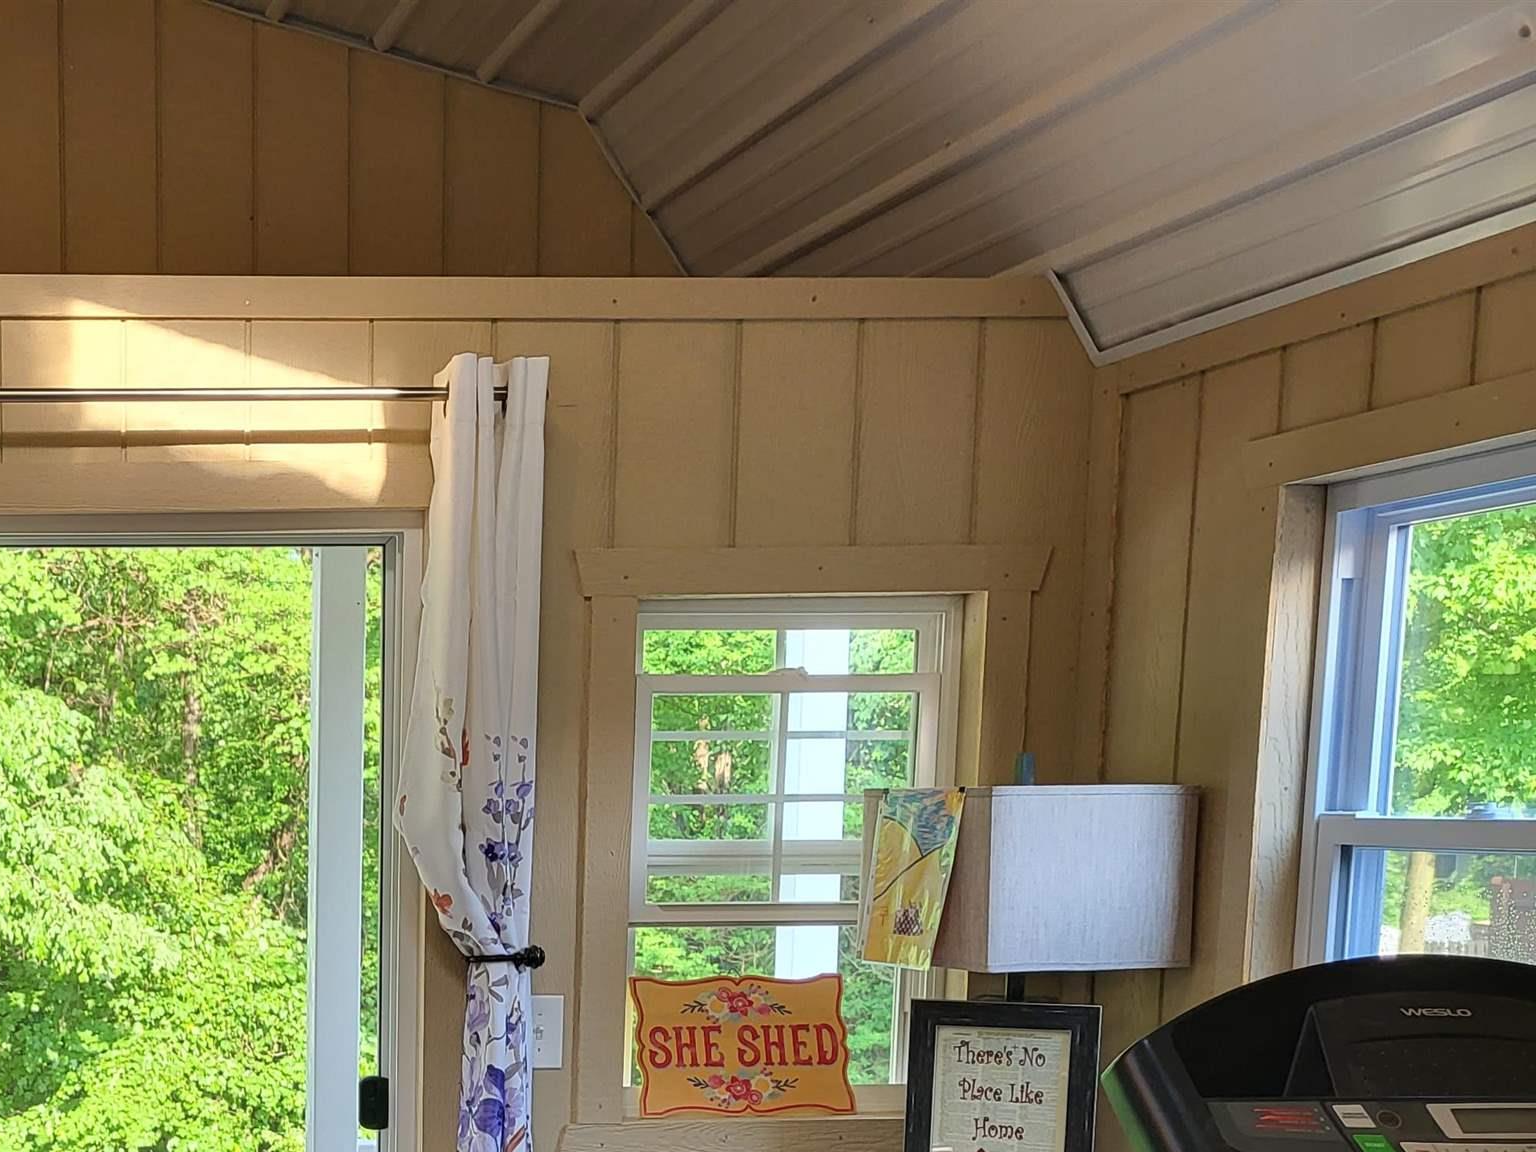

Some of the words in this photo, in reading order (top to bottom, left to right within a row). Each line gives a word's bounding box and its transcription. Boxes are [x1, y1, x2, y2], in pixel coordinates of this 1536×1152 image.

[1400, 1007, 1473, 1017] WESLO
[648, 1023, 725, 1069] SHE
[737, 1022, 839, 1068] SHED
[953, 1039, 1013, 1067] There's
[1019, 1047, 1046, 1068] No
[958, 1077, 1003, 1102] Place
[1008, 1081, 1045, 1105] Like
[971, 1116, 1025, 1141] Home
